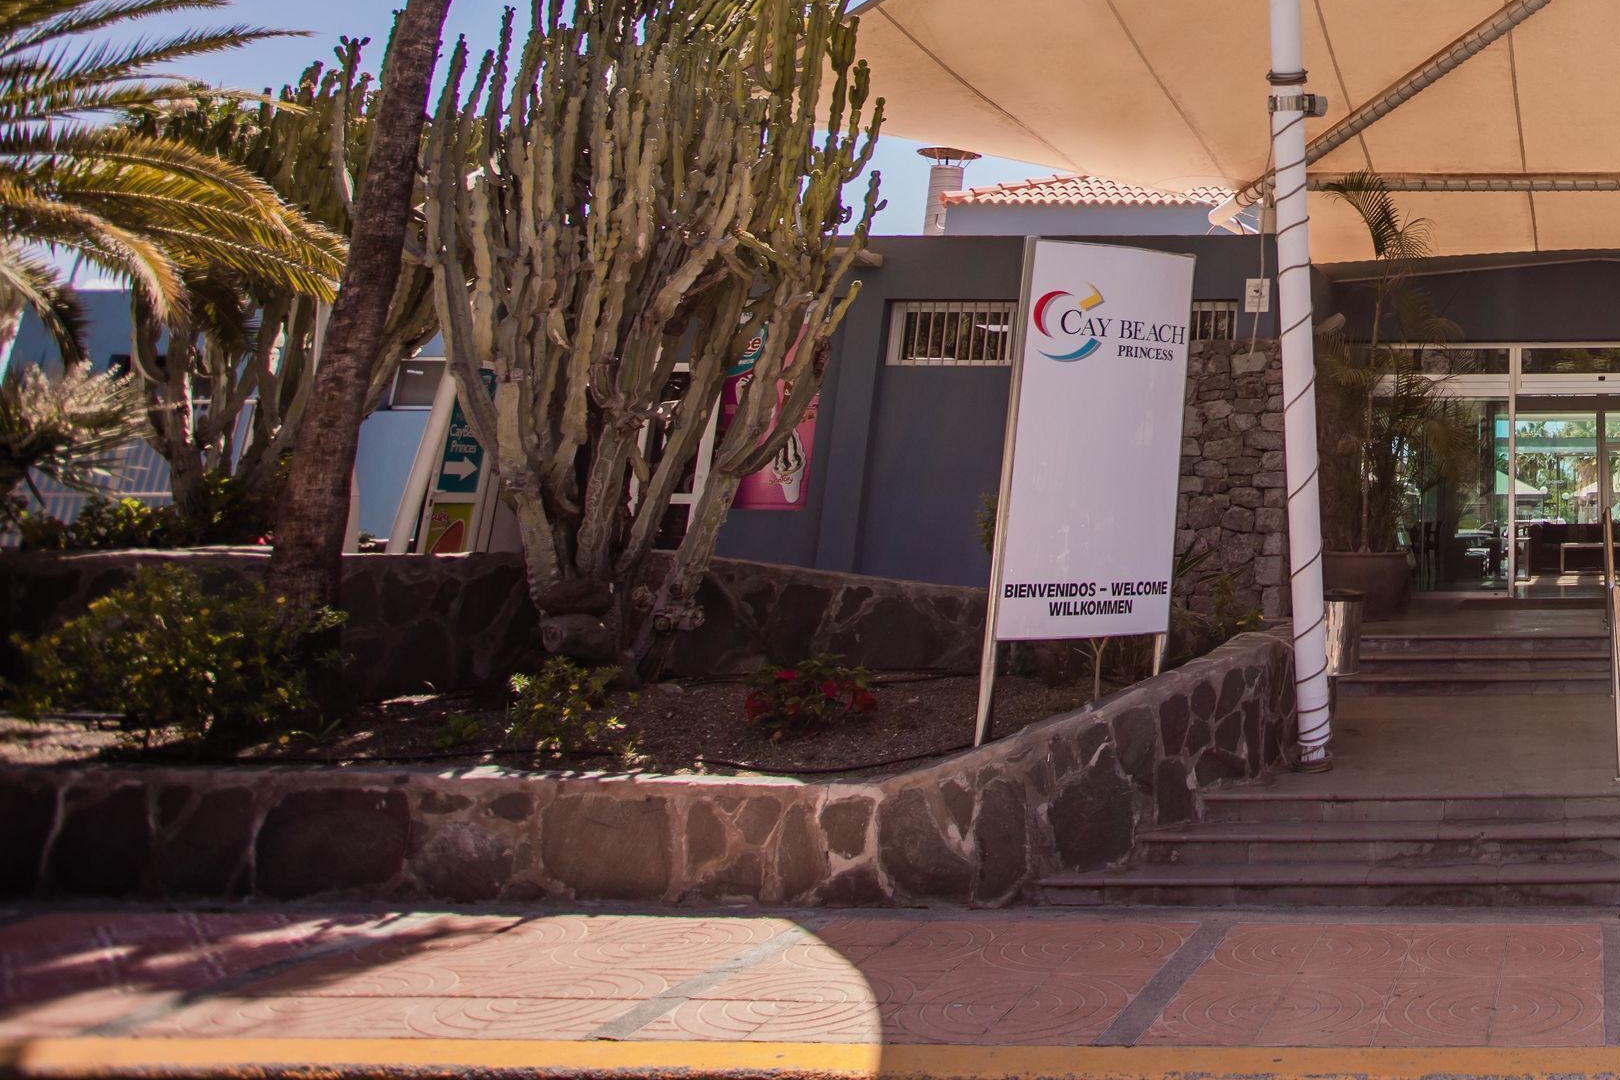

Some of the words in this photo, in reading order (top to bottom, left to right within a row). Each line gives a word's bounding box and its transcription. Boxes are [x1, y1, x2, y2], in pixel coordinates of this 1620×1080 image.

[1060, 309, 1112, 338] CAY
[1118, 319, 1186, 345] BEACH
[1117, 345, 1174, 361] PRINCESS
[1004, 582, 1096, 599] BIENVENIDOS
[1111, 581, 1168, 597] WELCOME
[1049, 599, 1134, 617] WILLKOMMEN
